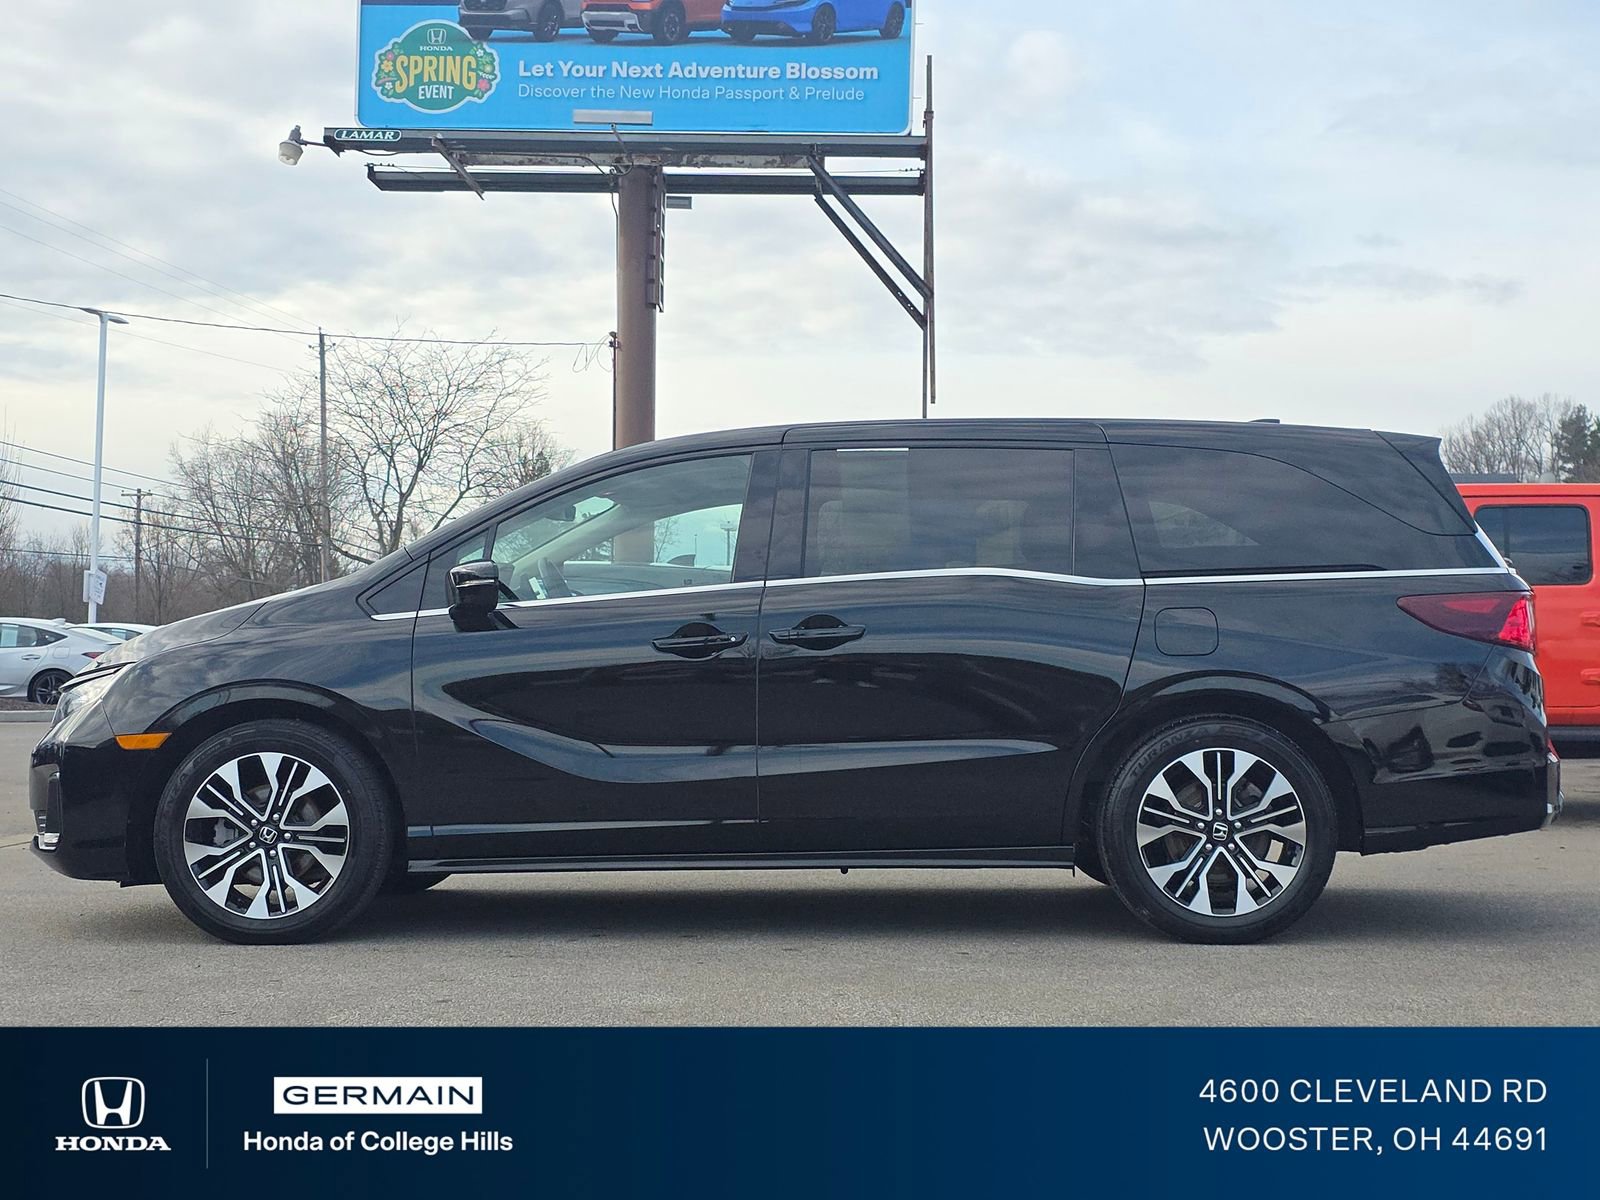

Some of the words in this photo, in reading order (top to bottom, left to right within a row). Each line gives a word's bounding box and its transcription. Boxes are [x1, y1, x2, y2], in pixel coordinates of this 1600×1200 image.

[395, 55, 477, 93] SPRING
[518, 60, 554, 77] Let
[559, 60, 606, 77] Your
[611, 61, 663, 78] Next
[668, 62, 781, 79] Adventure
[786, 62, 878, 79] Blossom
[418, 84, 454, 100] EVENT
[518, 83, 586, 98] Discover
[591, 85, 615, 98] the
[620, 85, 655, 99] New
[659, 86, 710, 99] Honda
[715, 86, 785, 102] Passport
[788, 87, 800, 100] &
[805, 86, 865, 101] Prelude
[341, 130, 394, 140] LAMAR
